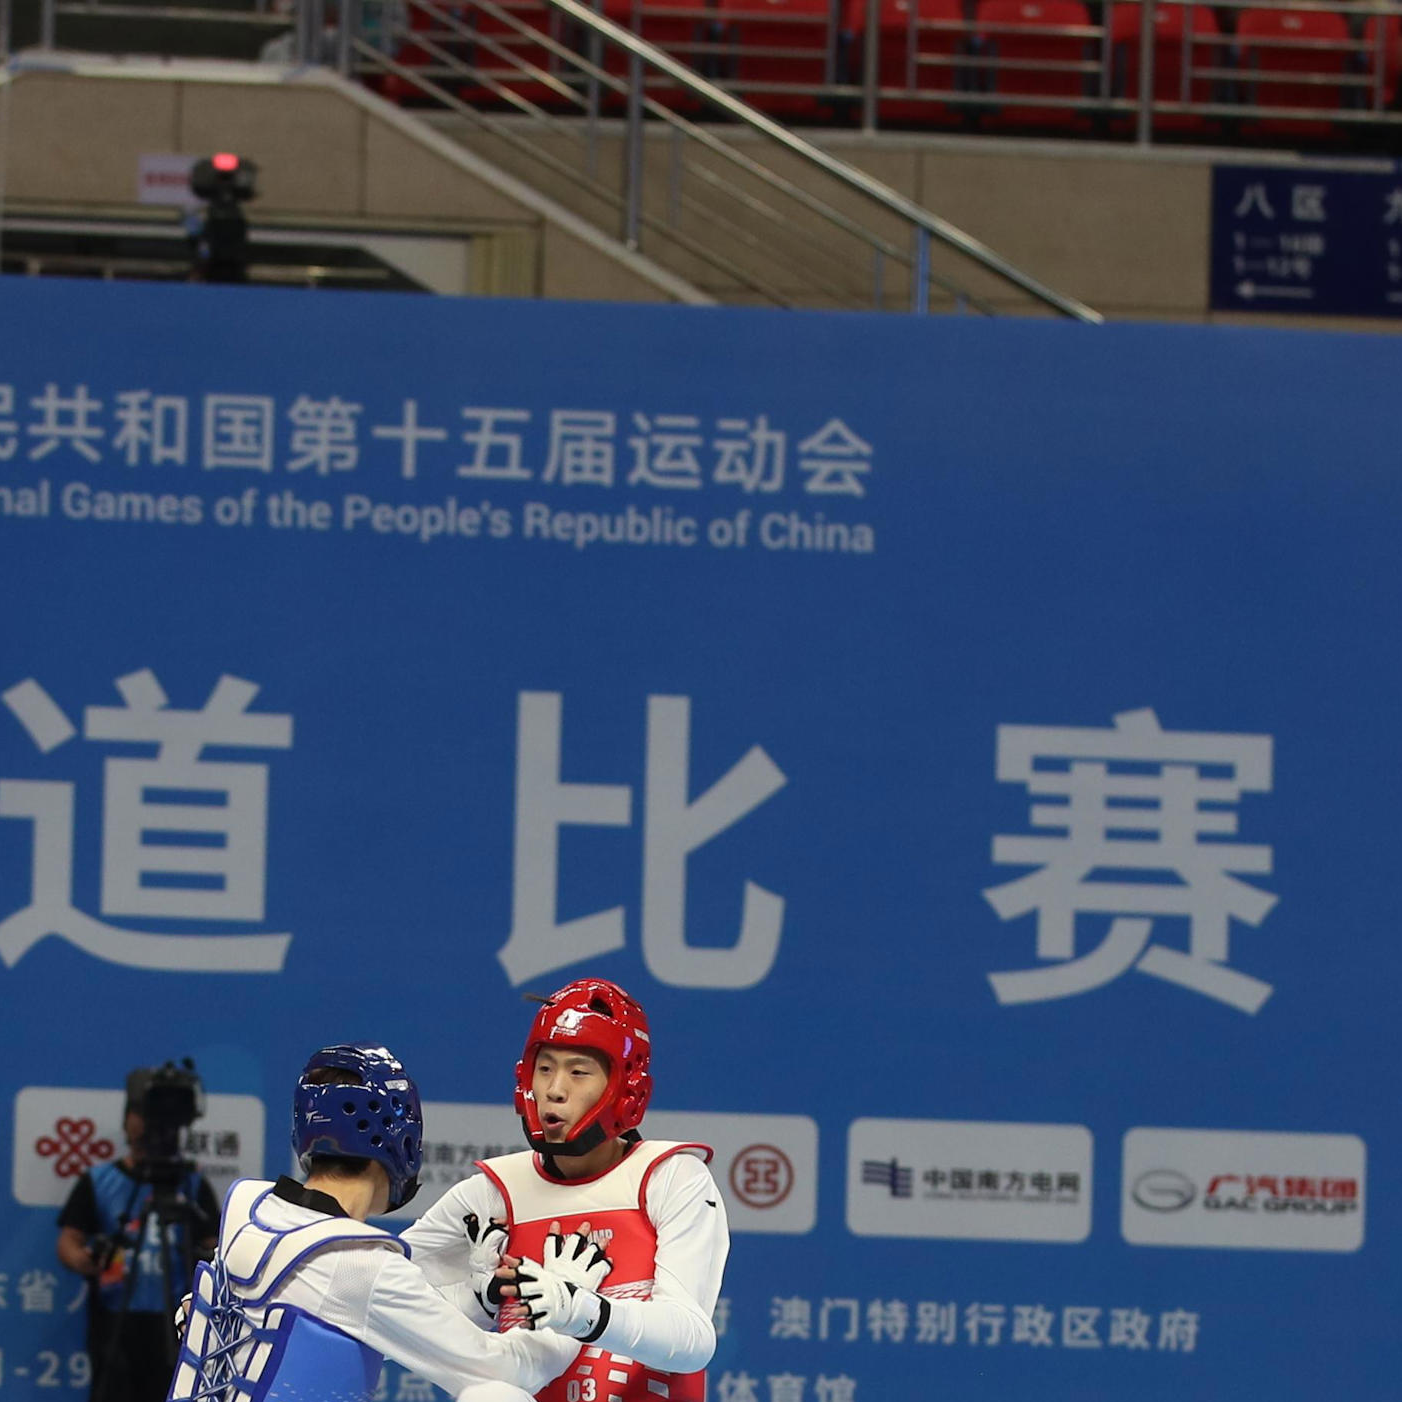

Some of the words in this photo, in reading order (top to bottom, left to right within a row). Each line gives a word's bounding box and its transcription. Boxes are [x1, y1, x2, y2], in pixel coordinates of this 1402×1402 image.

[62, 482, 201, 525] Games
[215, 489, 259, 528] of
[269, 491, 331, 530] the
[344, 495, 511, 543] People's
[524, 505, 698, 549] Republic
[708, 509, 751, 548] of
[760, 512, 874, 553] China
[923, 1166, 1081, 1193] 中国南方电网
[1206, 1174, 1358, 1199] 广汽集团
[769, 1296, 1199, 1354] 澳门特别行政区政府
[566, 1377, 597, 1402] 03
